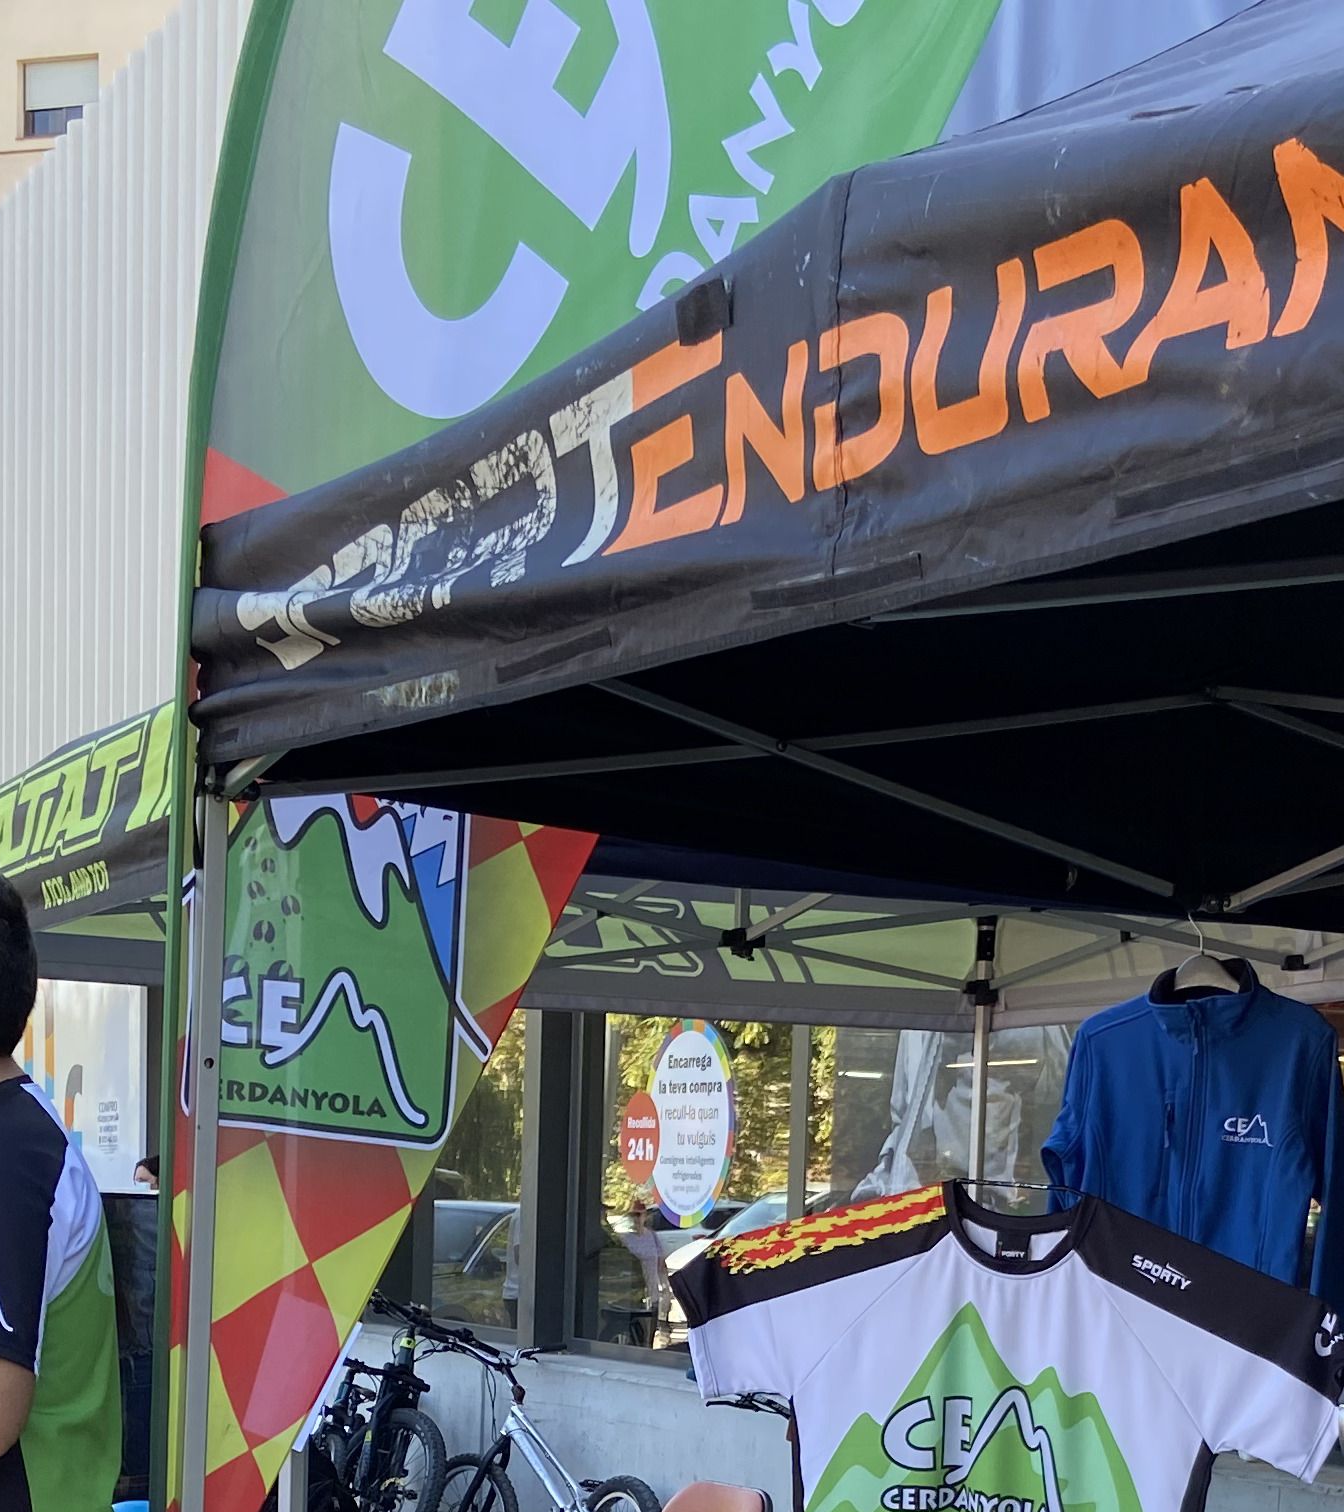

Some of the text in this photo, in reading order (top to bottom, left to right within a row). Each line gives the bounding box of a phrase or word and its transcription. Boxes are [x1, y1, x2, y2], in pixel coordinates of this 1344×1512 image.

[668, 1054, 712, 1071] Encarrega
[658, 1080, 722, 1098] la teva compra
[698, 1108, 719, 1125] quan
[676, 1133, 687, 1146] tu
[1001, 1250, 1025, 1258] PORTY
[1131, 1254, 1192, 1290] SPORTY
